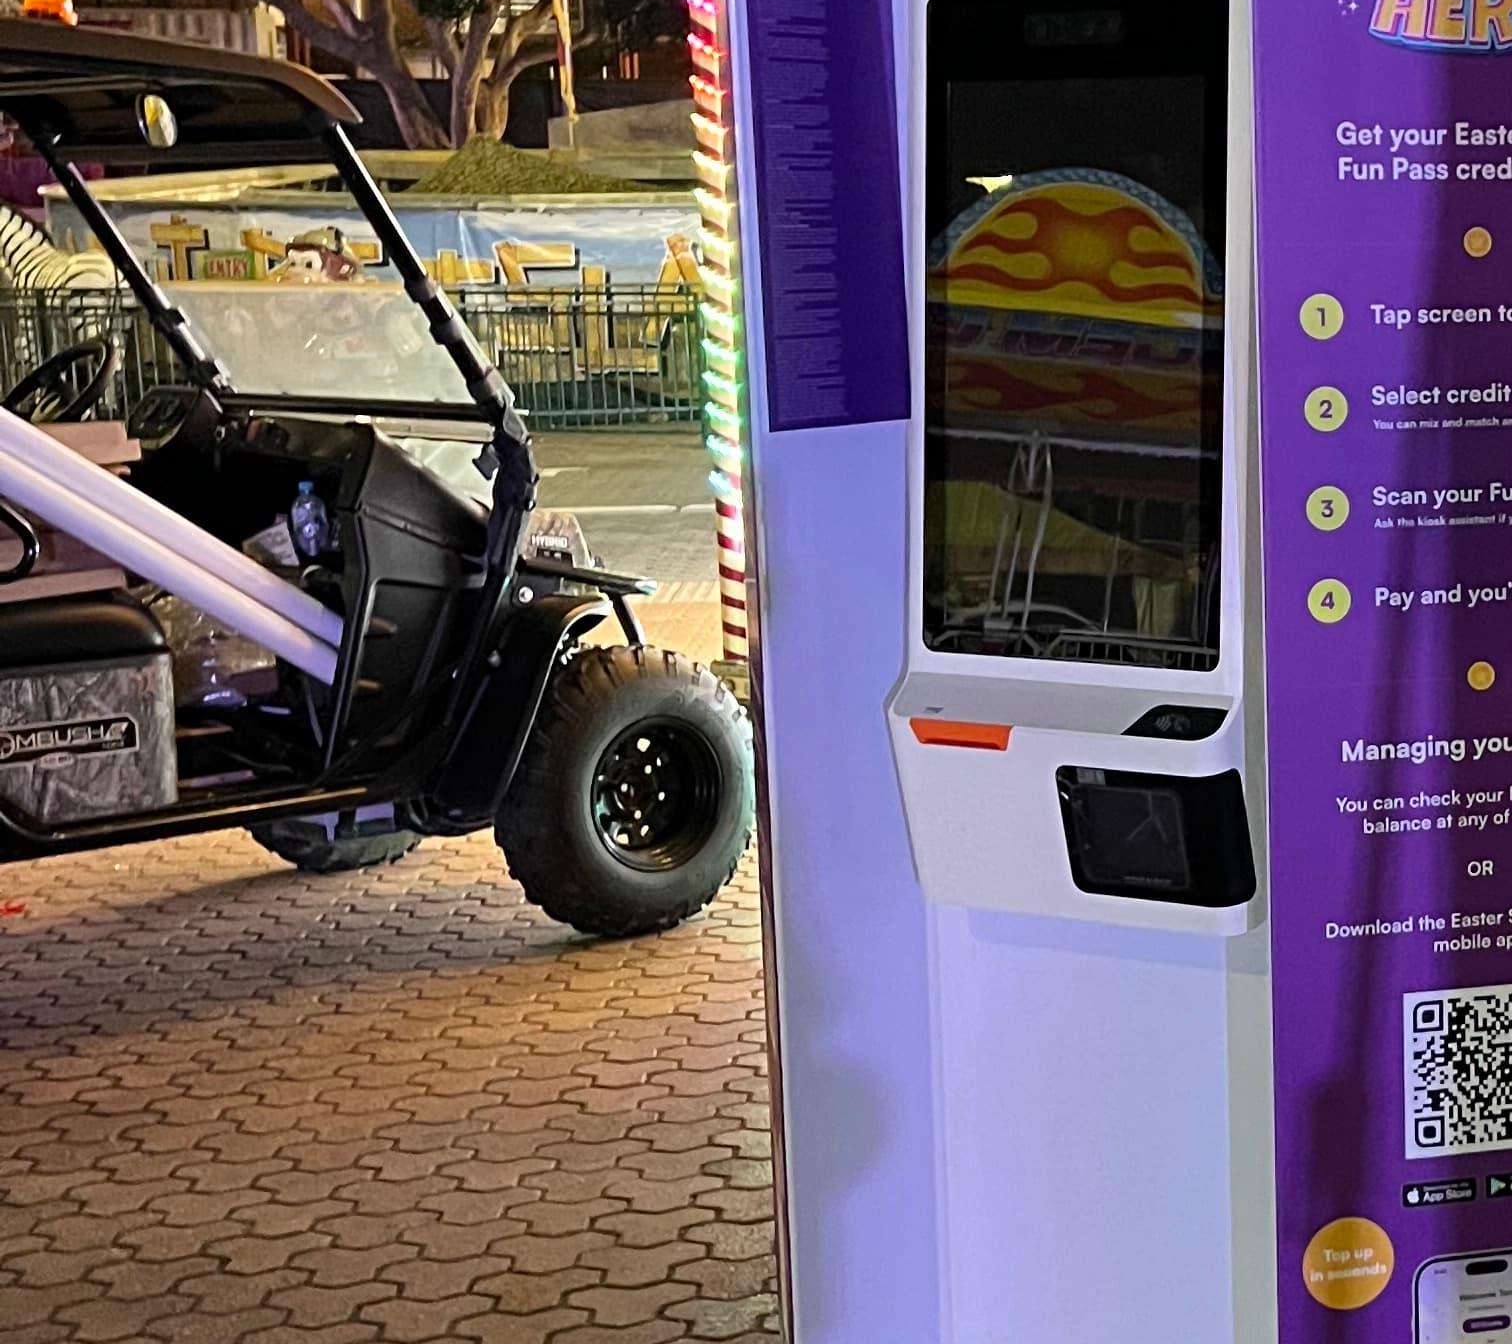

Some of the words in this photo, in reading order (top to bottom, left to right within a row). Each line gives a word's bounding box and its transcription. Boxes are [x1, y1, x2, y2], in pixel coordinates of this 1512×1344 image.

[1336, 122, 1382, 146] Get
[1390, 128, 1447, 152] your
[1338, 157, 1384, 180] Fun
[1392, 157, 1448, 180] Pass
[1317, 307, 1326, 327] 1
[1370, 305, 1411, 329] Tap
[1417, 308, 1491, 323] screen
[1371, 385, 1440, 405] Select
[1446, 383, 1511, 404] credit
[1319, 400, 1333, 418] 2
[1373, 419, 1393, 430] You
[1396, 420, 1417, 429] can
[1419, 419, 1438, 428] mix
[1442, 418, 1463, 427] and
[1465, 416, 1499, 427] match
[1373, 486, 1427, 506] Scan
[1433, 488, 1482, 509] your
[1320, 500, 1333, 518] 3
[1374, 518, 1393, 528] Ask
[1397, 517, 1415, 527] the
[1417, 515, 1446, 527] kiosk
[1498, 513, 1505, 524] if
[1320, 591, 1335, 609] 4
[1375, 587, 1414, 611] Pay
[1421, 584, 1461, 604] and
[1342, 736, 1466, 764] Managing
[1336, 796, 1368, 813] You
[1373, 796, 1404, 810] can
[1409, 790, 1460, 808] check
[1466, 790, 1504, 808] your
[1364, 818, 1432, 834] balance
[1437, 815, 1452, 828] at
[1458, 811, 1488, 830] any
[1494, 808, 1510, 824] of
[1467, 860, 1494, 876] OR
[1325, 916, 1413, 939] Download
[1418, 915, 1445, 932] the
[1451, 911, 1503, 929] Easter
[1433, 934, 1491, 953] mobile
[1423, 1192, 1443, 1203] App
[1446, 1188, 1472, 1199] Store
[1323, 1248, 1350, 1263] Top
[1354, 1248, 1373, 1261] up
[1310, 1270, 1323, 1282] in
